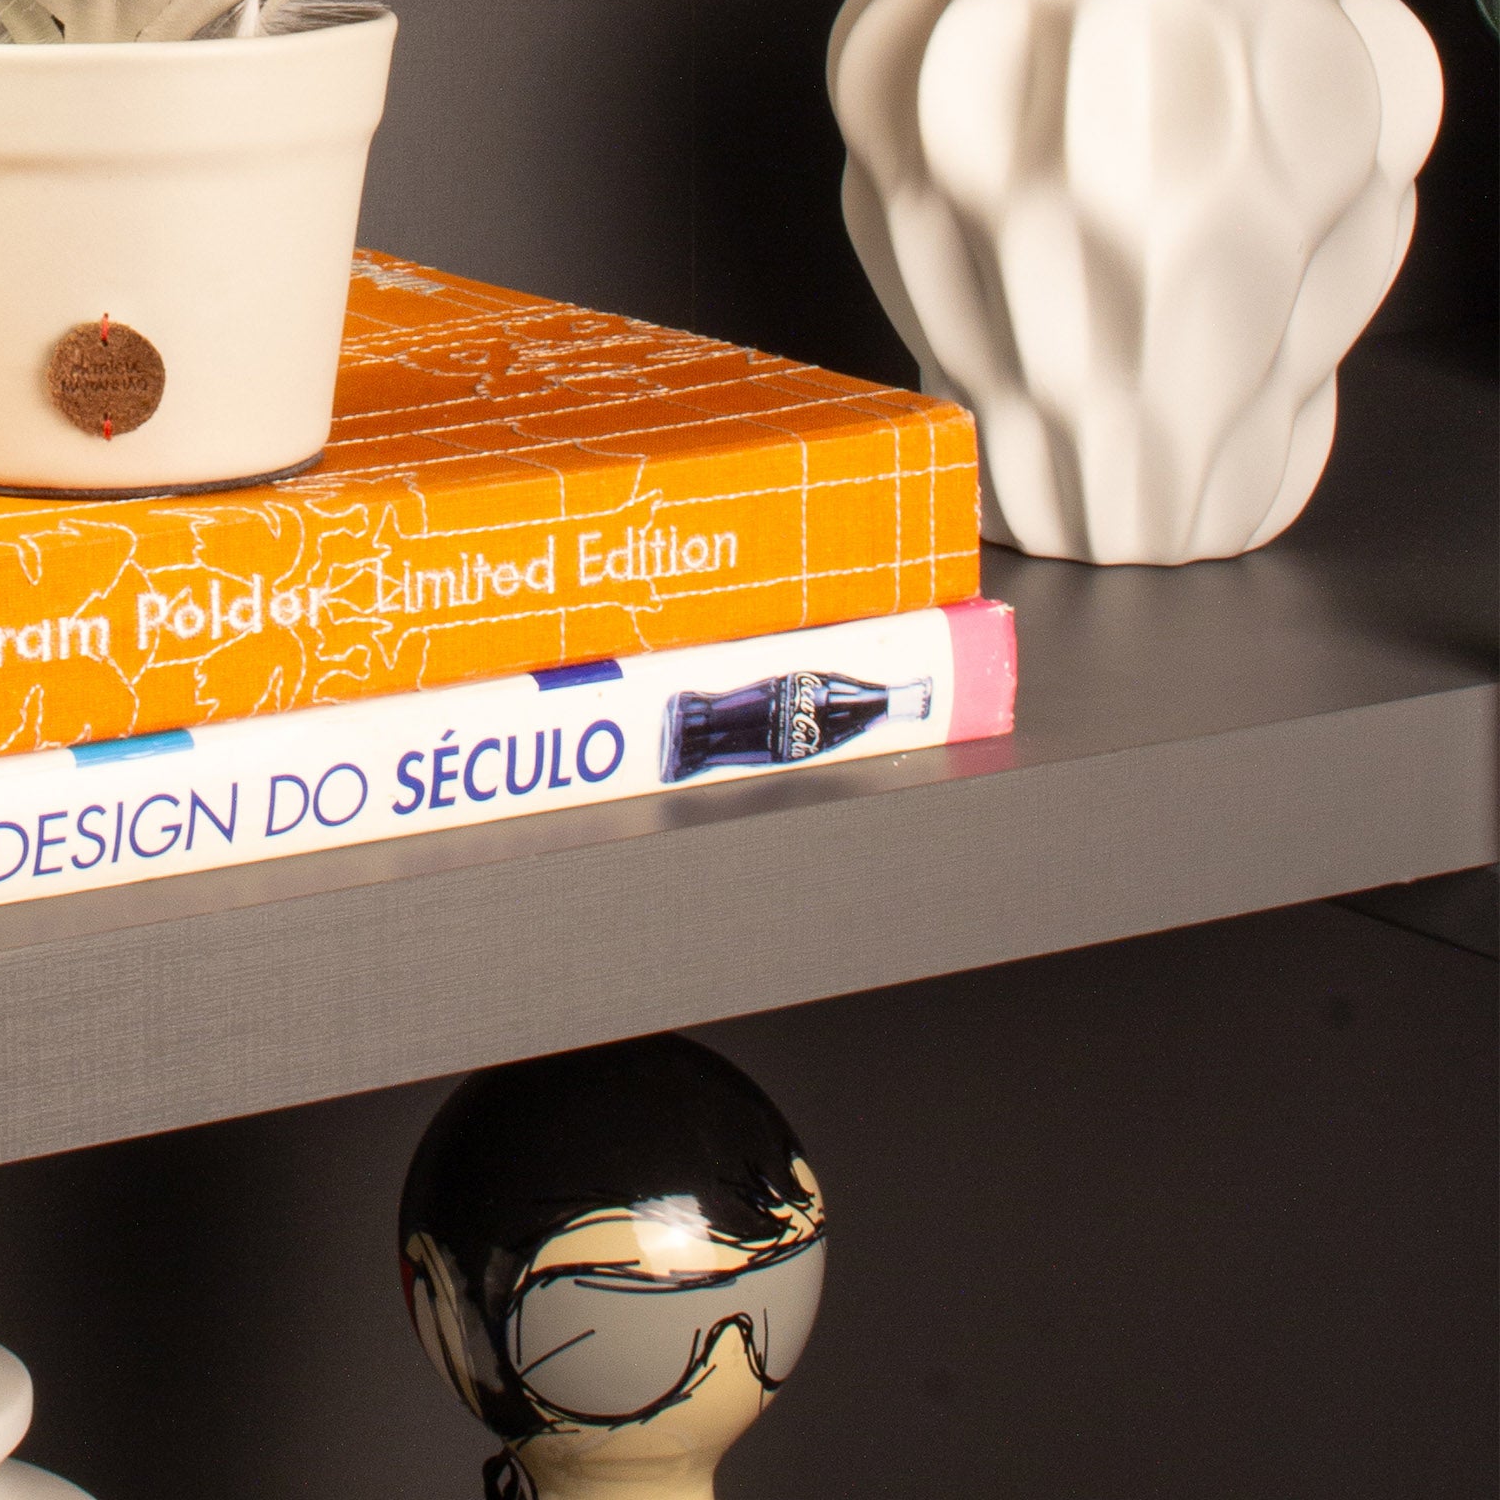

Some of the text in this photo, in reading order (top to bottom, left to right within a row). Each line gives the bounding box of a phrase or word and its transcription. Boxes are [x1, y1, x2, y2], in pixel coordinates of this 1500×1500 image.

[137, 573, 329, 650] Polder
[375, 534, 555, 614] Limited
[578, 525, 738, 587] Edition
[265, 763, 369, 838] DO
[392, 719, 627, 816] SÉCULO
